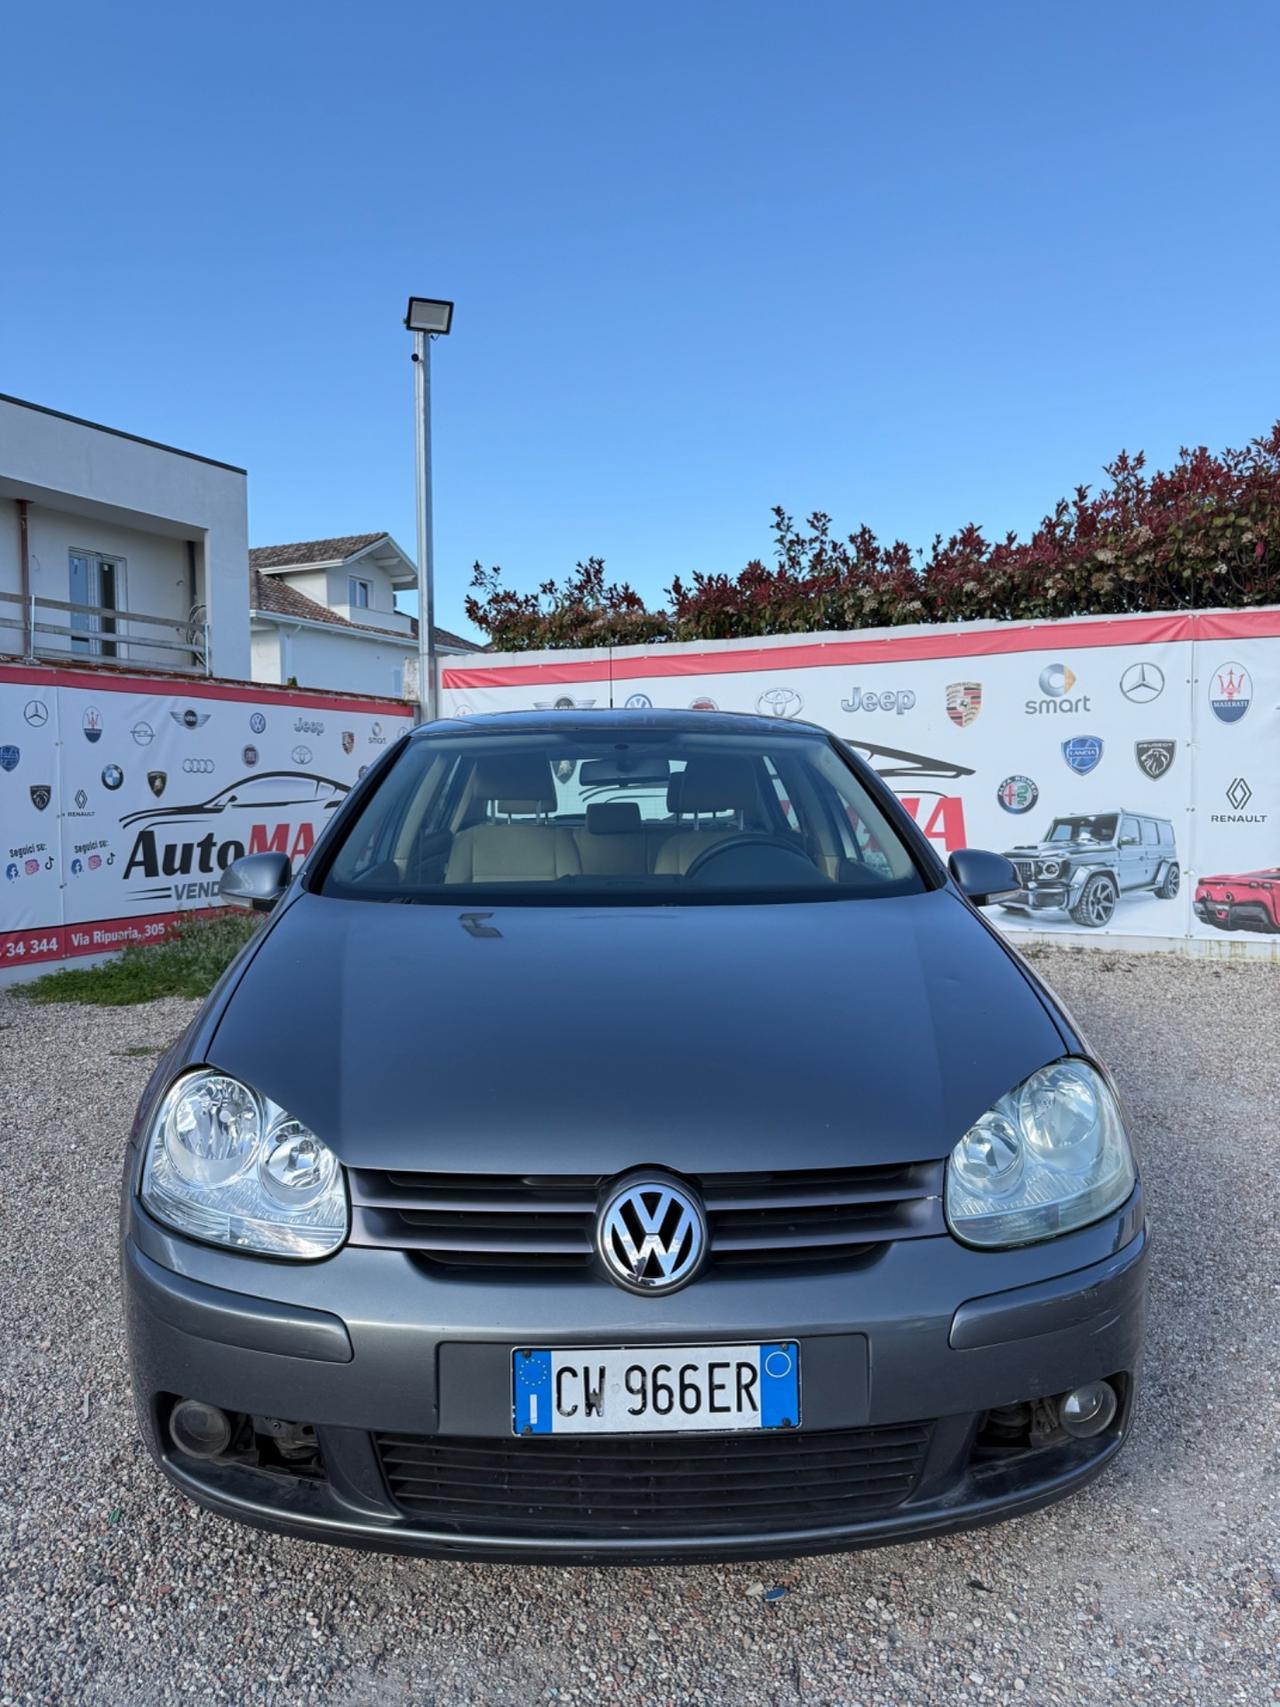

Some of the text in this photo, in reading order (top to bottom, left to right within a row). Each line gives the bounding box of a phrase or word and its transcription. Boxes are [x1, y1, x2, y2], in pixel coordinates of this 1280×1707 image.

[841, 687, 916, 715] Jeep
[1024, 695, 1091, 715] smart
[1213, 700, 1248, 708] MASERATI
[293, 717, 325, 736] Jeep
[1211, 815, 1267, 823] RENAULT
[71, 933, 90, 947] Via
[93, 926, 142, 944] Ripuaria,
[144, 922, 165, 937] 305
[6, 937, 58, 957] 34 344
[555, 1361, 759, 1417] CW 966ER
